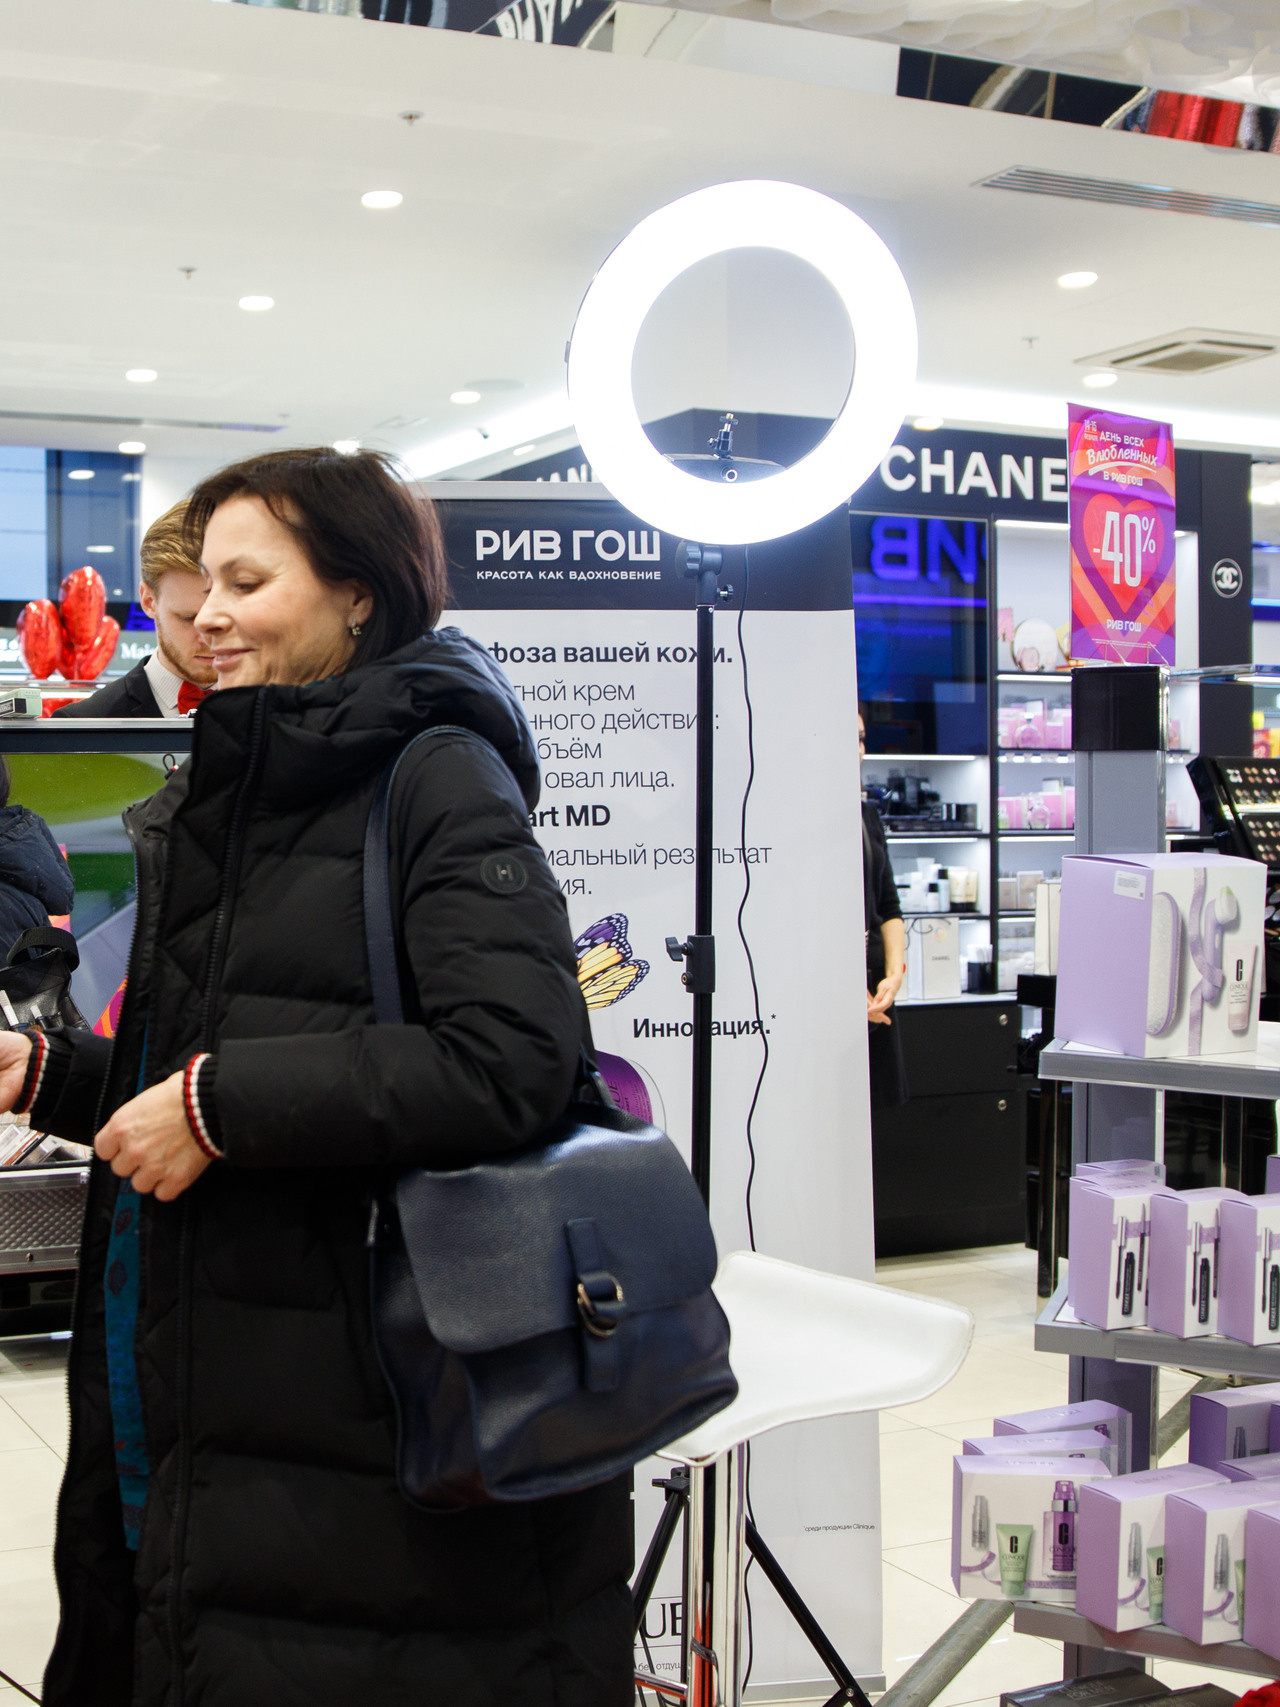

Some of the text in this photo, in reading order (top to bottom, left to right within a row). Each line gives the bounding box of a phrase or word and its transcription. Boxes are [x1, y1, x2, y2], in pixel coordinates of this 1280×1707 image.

[1100, 431, 1144, 447] ДЕНЬ ВСЕХ
[1086, 444, 1158, 466] Влюбленных
[1104, 471, 1109, 480] В
[1127, 475, 1143, 486] ГОШ
[476, 530, 661, 561] РИВ ГОШ
[1093, 510, 1156, 588] -40%
[476, 571, 661, 581] КРАСОТА КАК ВДОХНОВЕНИЕ
[1107, 619, 1142, 632] РИВ ГОШ
[564, 641, 651, 664] вашей
[573, 684, 636, 706] крем
[602, 709, 720, 734] действи:
[545, 771, 675, 791] овал лица.
[566, 805, 611, 826] MD
[653, 847, 773, 869] резльтат
